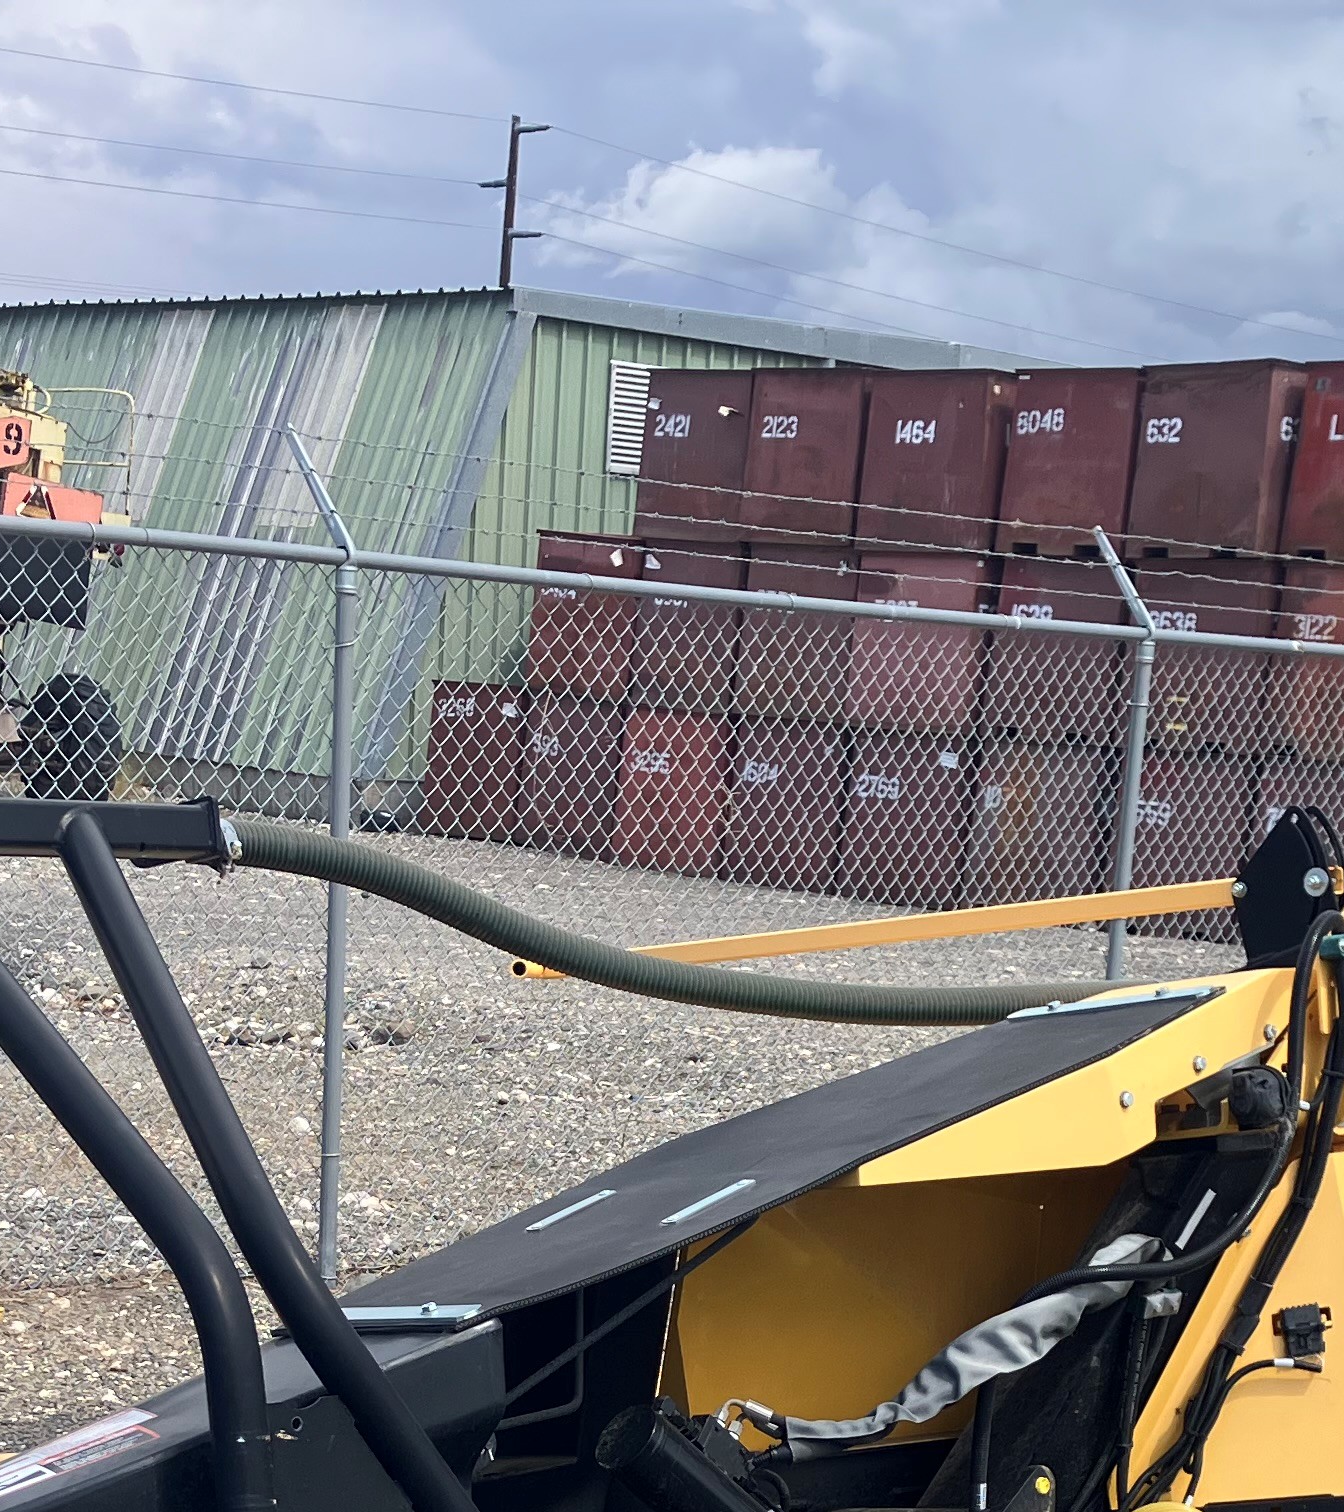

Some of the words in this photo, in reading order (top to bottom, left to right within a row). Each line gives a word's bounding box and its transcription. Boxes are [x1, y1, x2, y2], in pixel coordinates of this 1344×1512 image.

[654, 414, 691, 437] 2421
[761, 415, 798, 438] 2123
[895, 419, 937, 444] 1464
[1146, 417, 1183, 444] 632
[3, 423, 23, 455] 9
[1292, 615, 1339, 641] 3122
